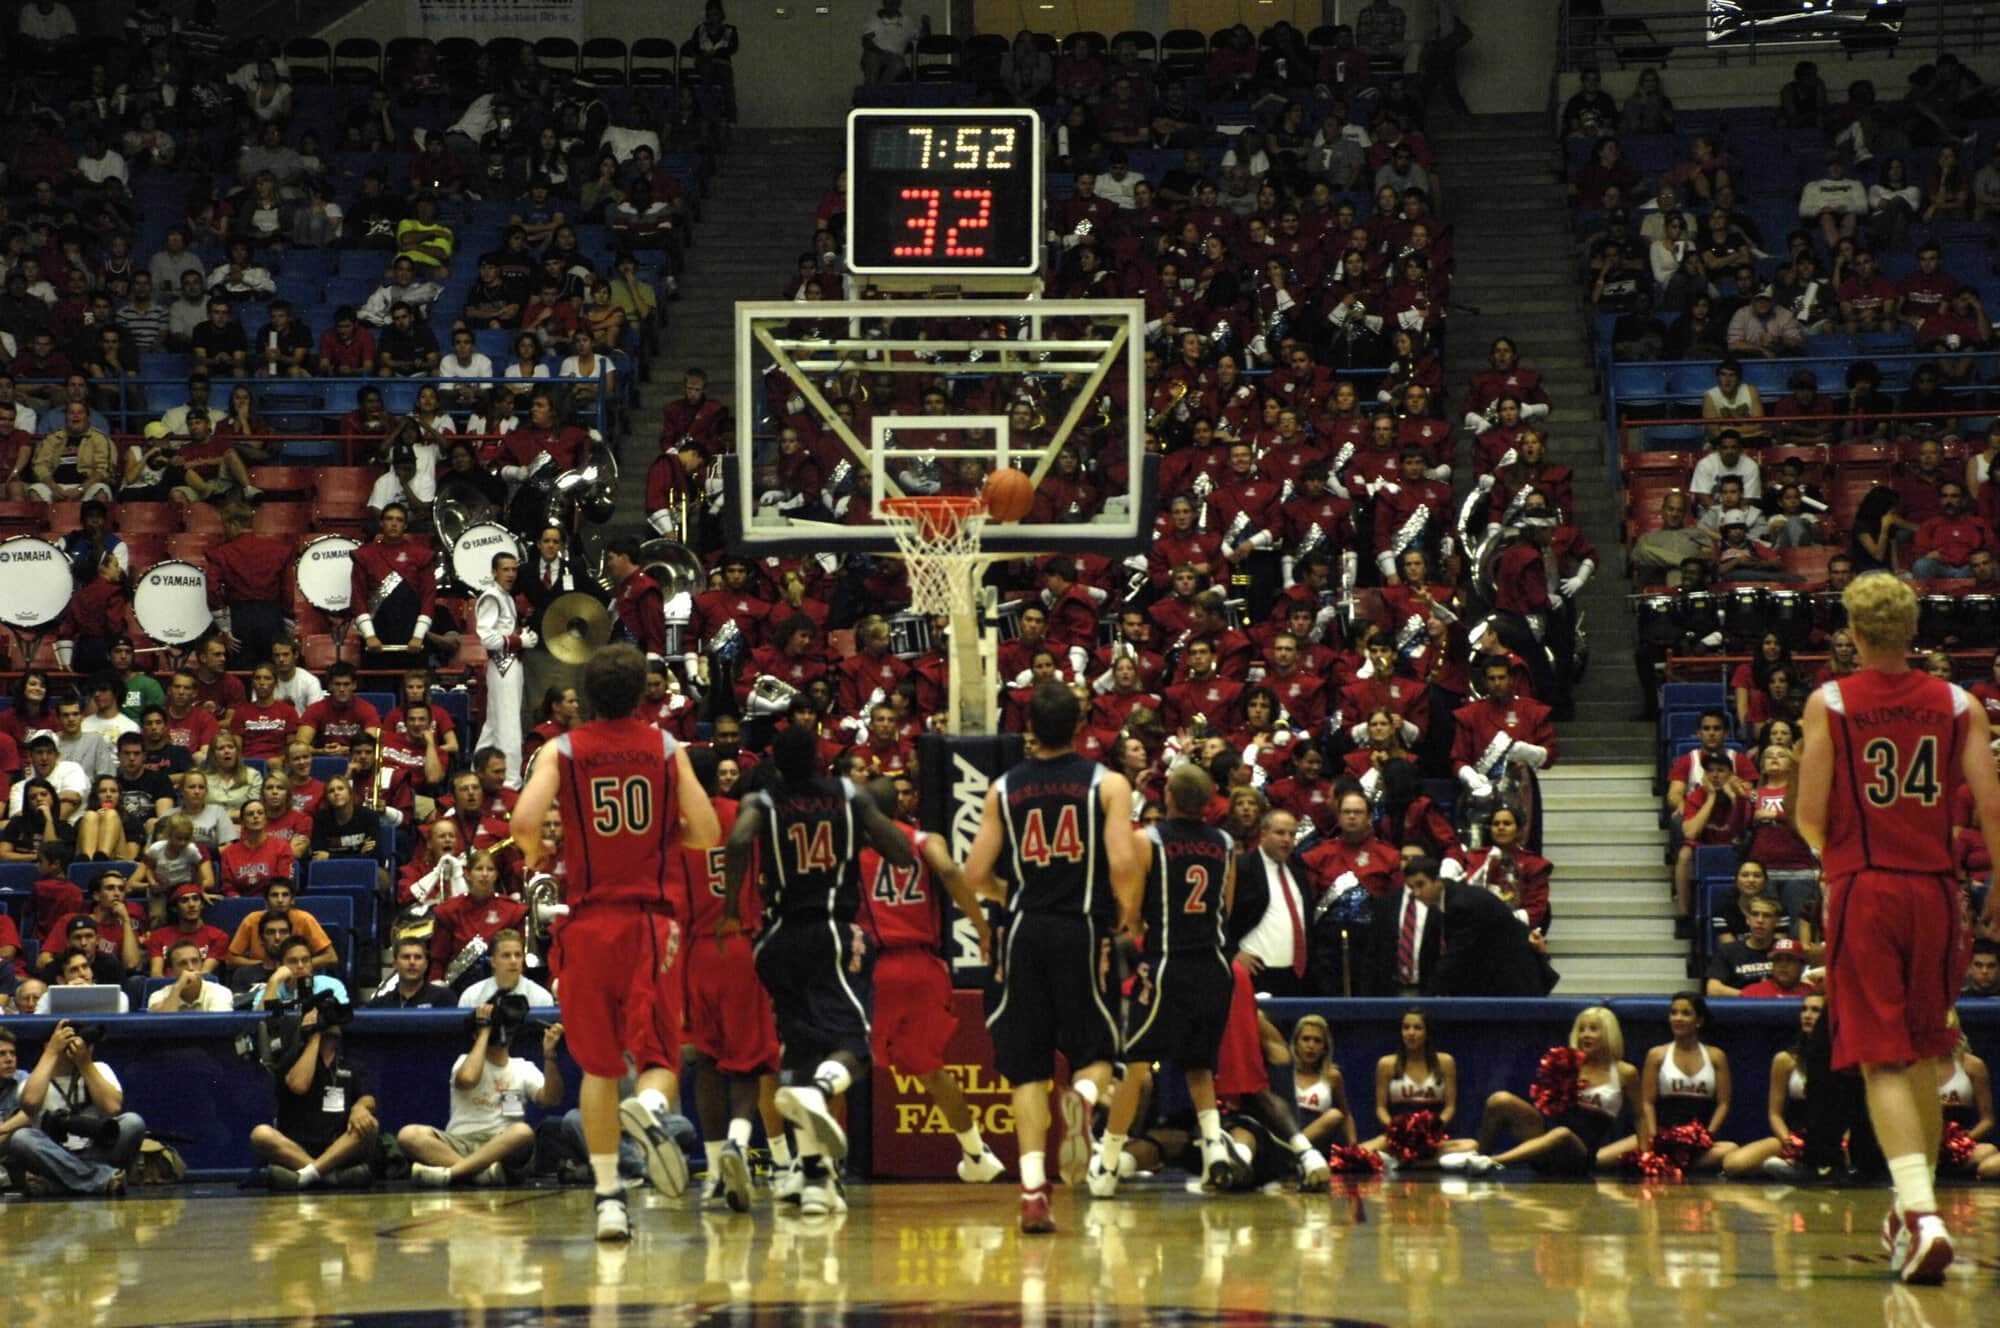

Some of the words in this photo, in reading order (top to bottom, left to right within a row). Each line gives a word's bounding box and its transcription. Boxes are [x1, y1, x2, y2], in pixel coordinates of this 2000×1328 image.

[908, 128, 1015, 169] 7:52
[894, 189, 992, 256] 32
[11, 551, 52, 563] YAMAHA
[321, 550, 352, 560] YAMAH
[471, 534, 504, 547] YAMAHA
[162, 575, 202, 587] YAMAHA
[1863, 735, 1942, 808] 34
[590, 774, 652, 837] 50
[786, 820, 837, 874] 14
[952, 751, 990, 968] ARIZNA
[1020, 804, 1085, 867] 44
[871, 856, 926, 907] 42
[1184, 864, 1209, 914] 2
